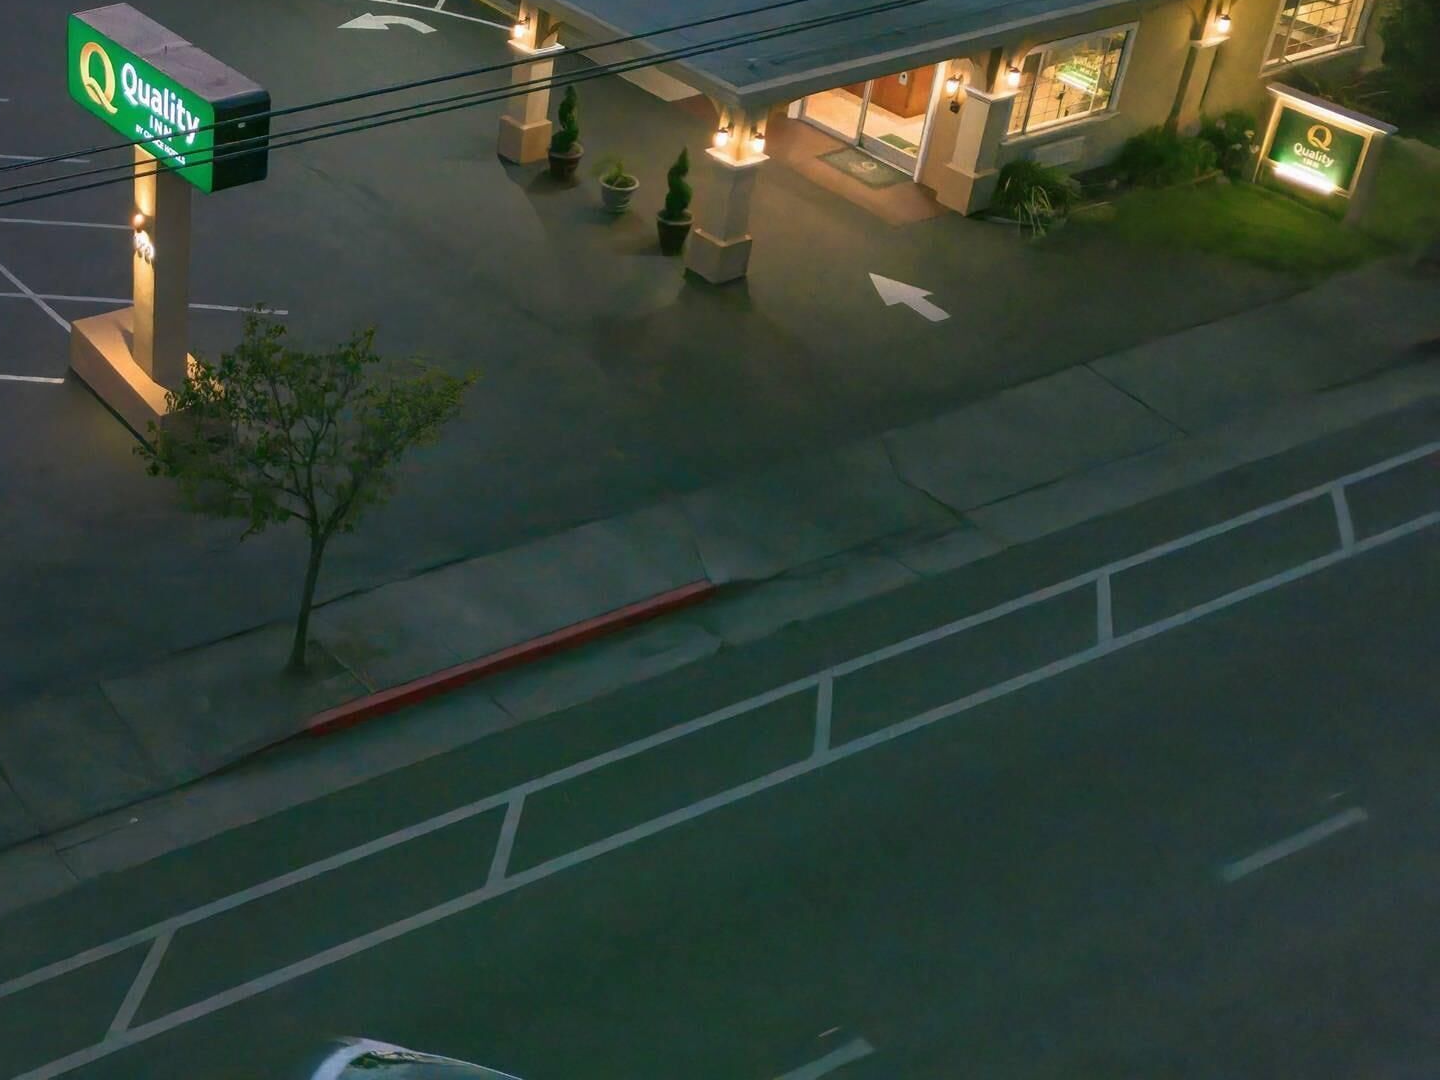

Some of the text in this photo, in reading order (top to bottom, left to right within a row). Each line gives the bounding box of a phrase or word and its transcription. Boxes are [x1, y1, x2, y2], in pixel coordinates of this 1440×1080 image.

[79, 41, 118, 114] Q
[121, 62, 200, 146] Quality
[149, 115, 173, 142] INN
[1307, 124, 1332, 151] Q
[1293, 142, 1335, 168] Quality
